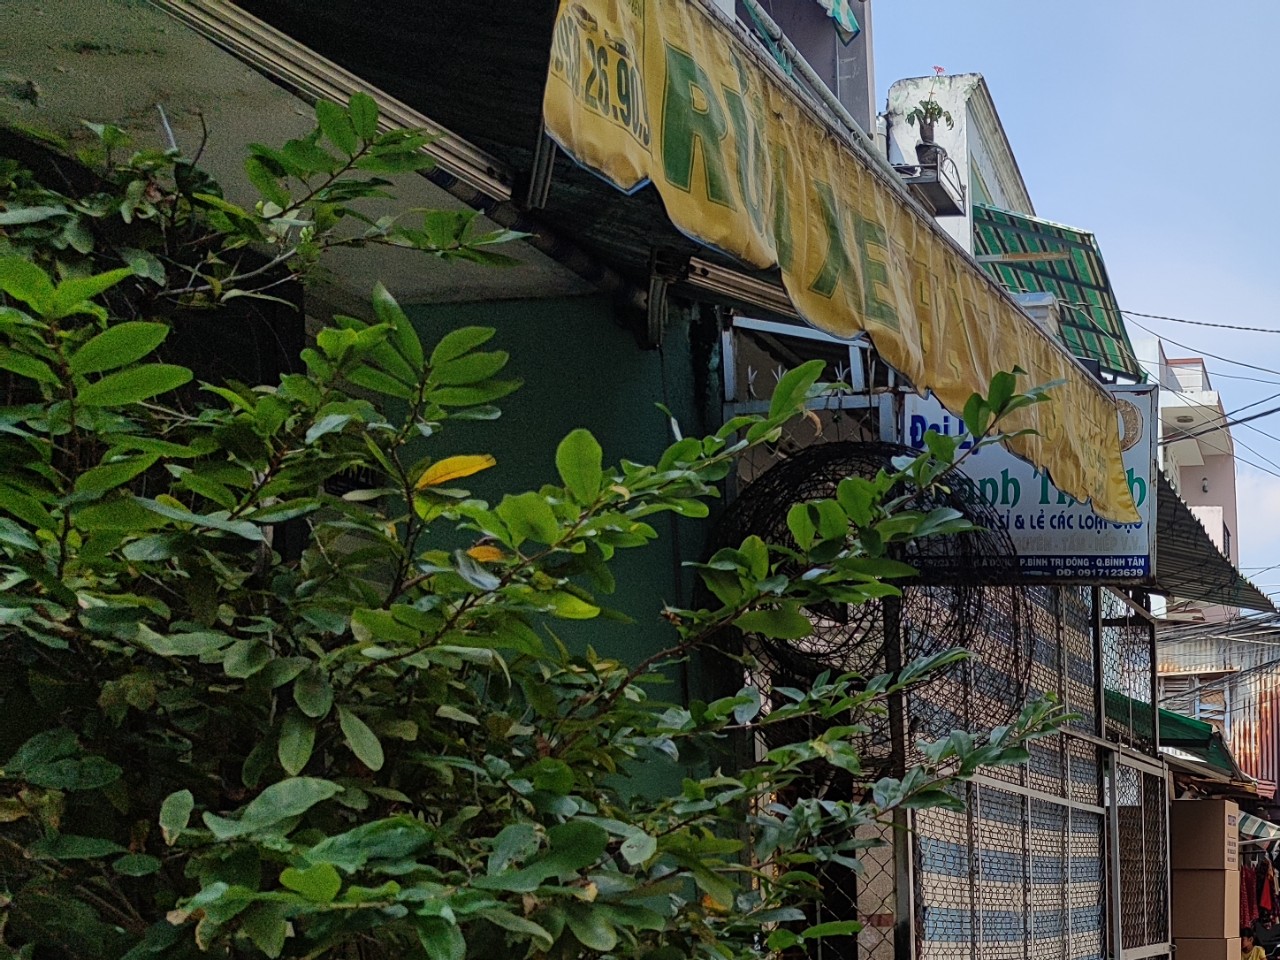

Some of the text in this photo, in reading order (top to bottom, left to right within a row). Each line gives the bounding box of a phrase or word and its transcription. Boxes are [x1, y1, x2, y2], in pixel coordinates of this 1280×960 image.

[806, 178, 901, 333] XE
[1014, 514, 1025, 530] &
[1030, 508, 1045, 530] LẺ
[1049, 510, 1074, 530] CÁC
[1020, 556, 1048, 567] P.BÌNH
[1050, 557, 1064, 569] TRỊ
[1065, 556, 1089, 567] ĐÔNG
[1096, 556, 1126, 567] Q.BÌNH
[1127, 556, 1145, 567] TÂN
[1077, 568, 1144, 577] 0917123639
